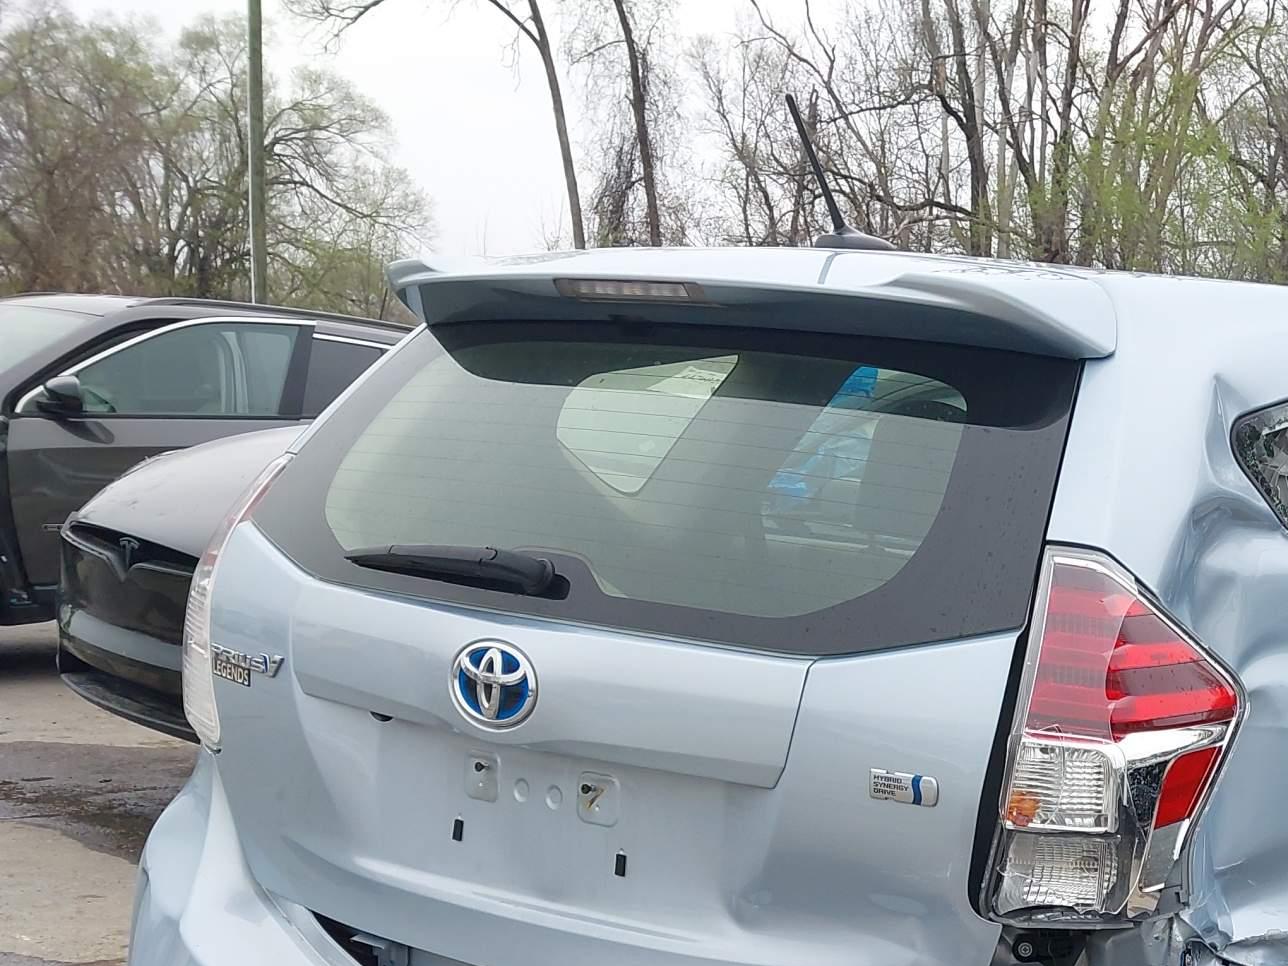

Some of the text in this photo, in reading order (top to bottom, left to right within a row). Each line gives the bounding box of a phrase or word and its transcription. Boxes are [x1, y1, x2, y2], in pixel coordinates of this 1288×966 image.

[213, 659, 249, 687] LEGENDS
[872, 774, 903, 784] HYBRID
[872, 781, 910, 792] SYNERGY
[872, 788, 897, 797] DRIVE
